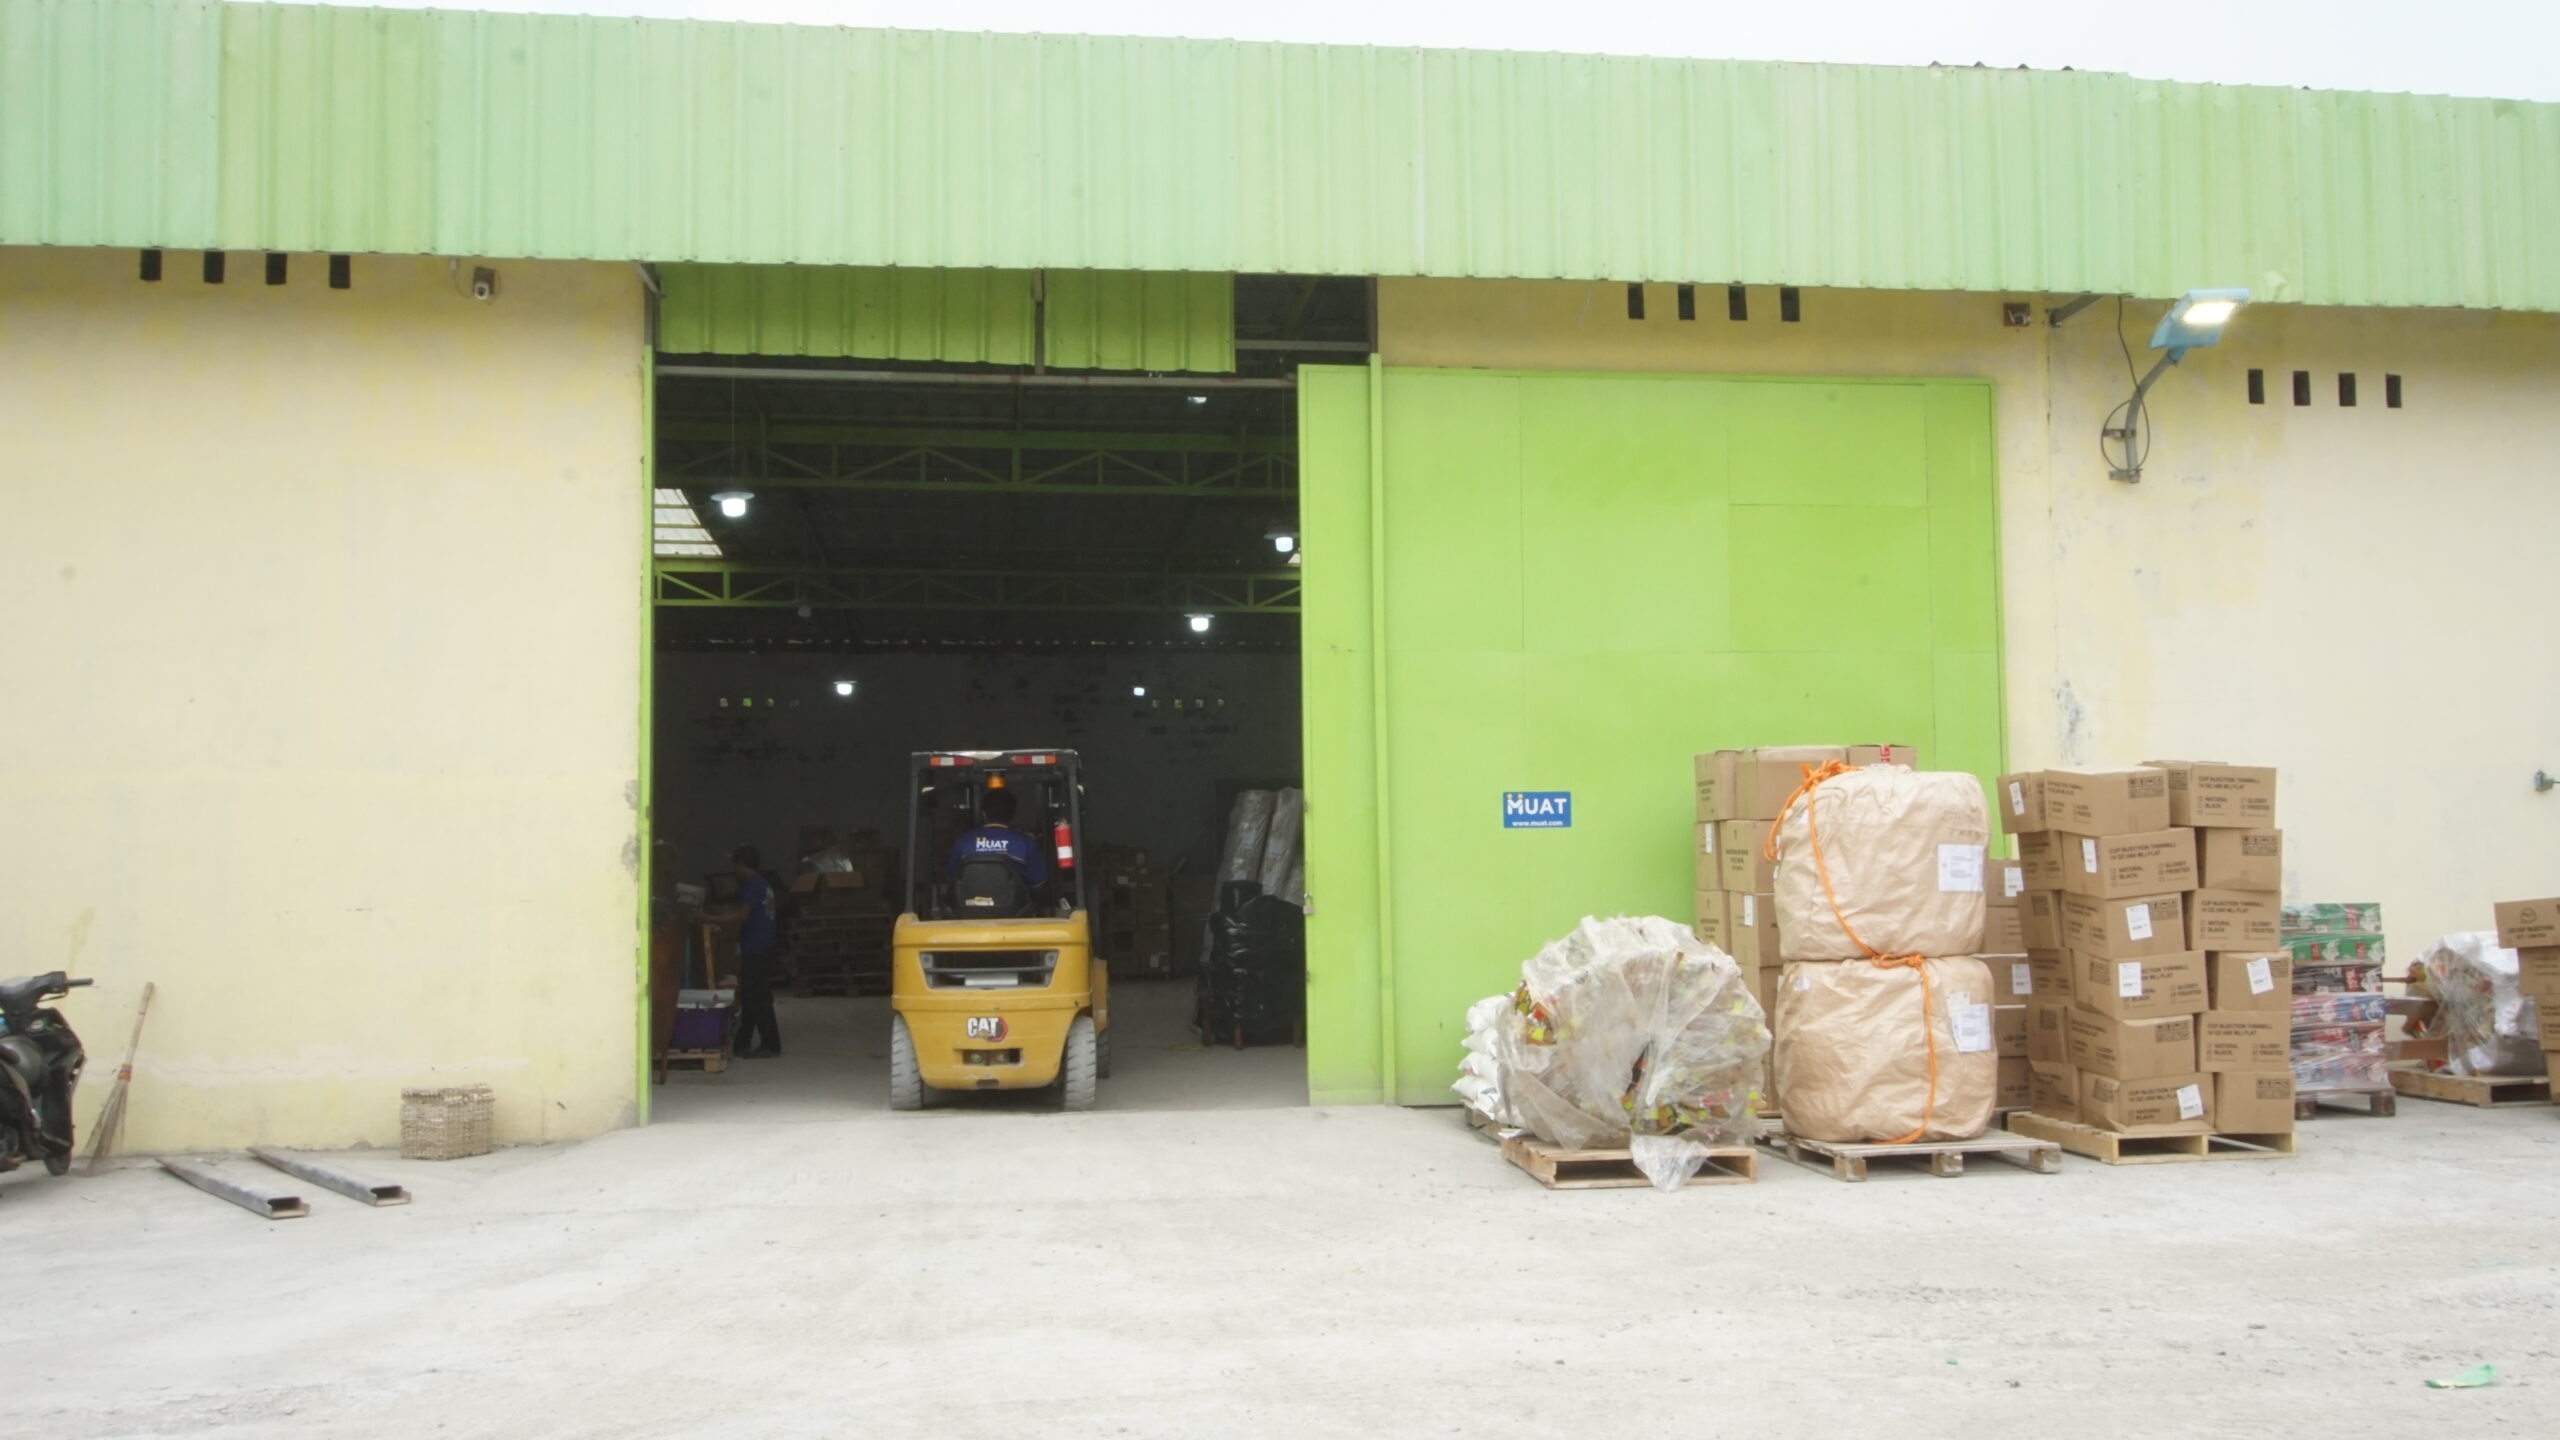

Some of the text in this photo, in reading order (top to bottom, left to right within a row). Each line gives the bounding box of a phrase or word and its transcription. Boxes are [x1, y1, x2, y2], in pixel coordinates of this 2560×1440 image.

[1506, 793, 1568, 815] MUAT
[976, 836, 1008, 849] MUAT
[967, 1017, 998, 1038] CAT
